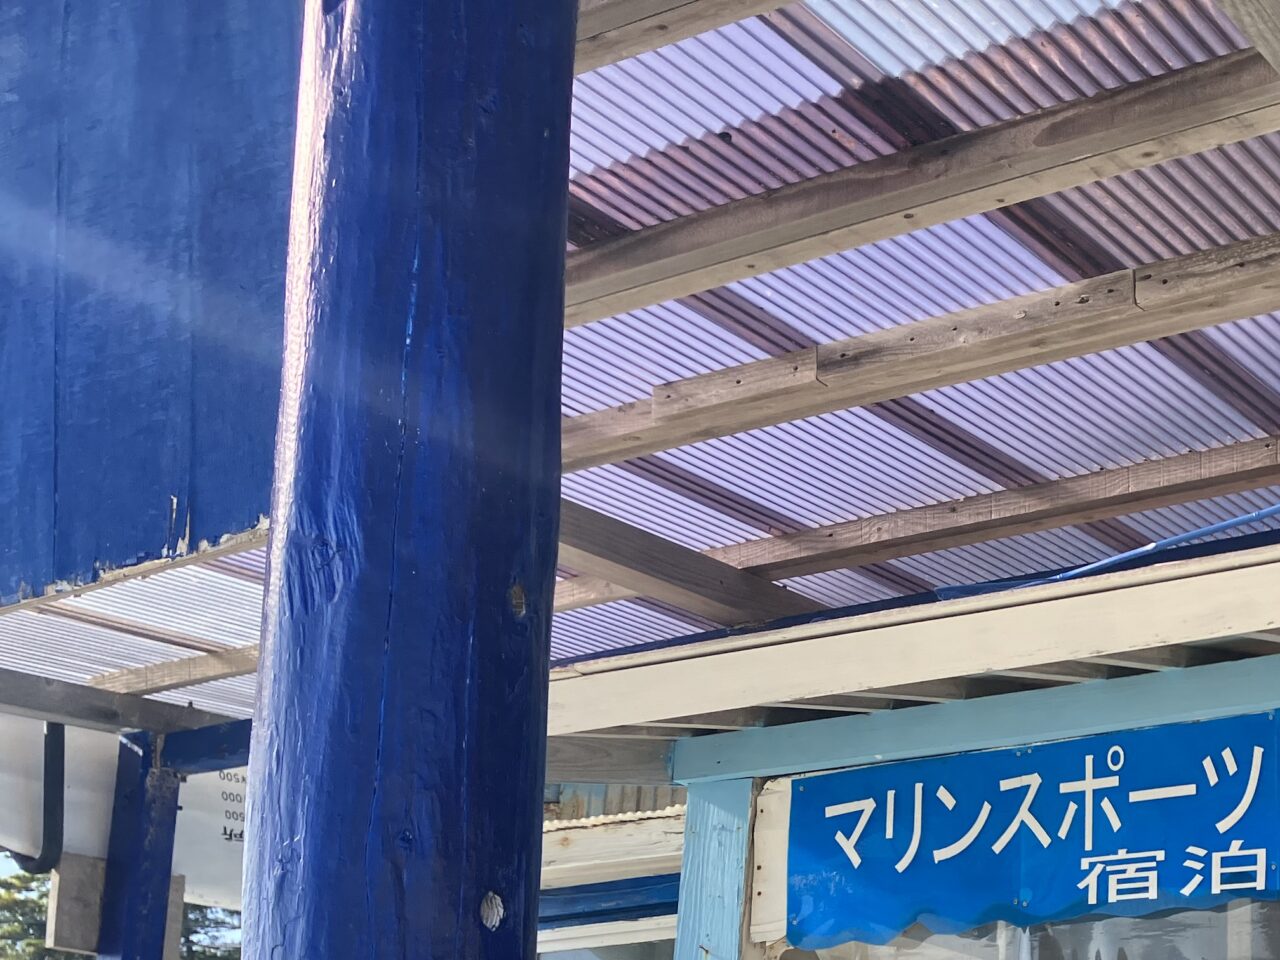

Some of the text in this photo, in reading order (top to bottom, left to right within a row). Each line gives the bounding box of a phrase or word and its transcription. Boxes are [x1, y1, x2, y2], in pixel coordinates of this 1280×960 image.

[824, 744, 1266, 873] マリンスポーツ
[1076, 838, 1268, 906] 宿泊
